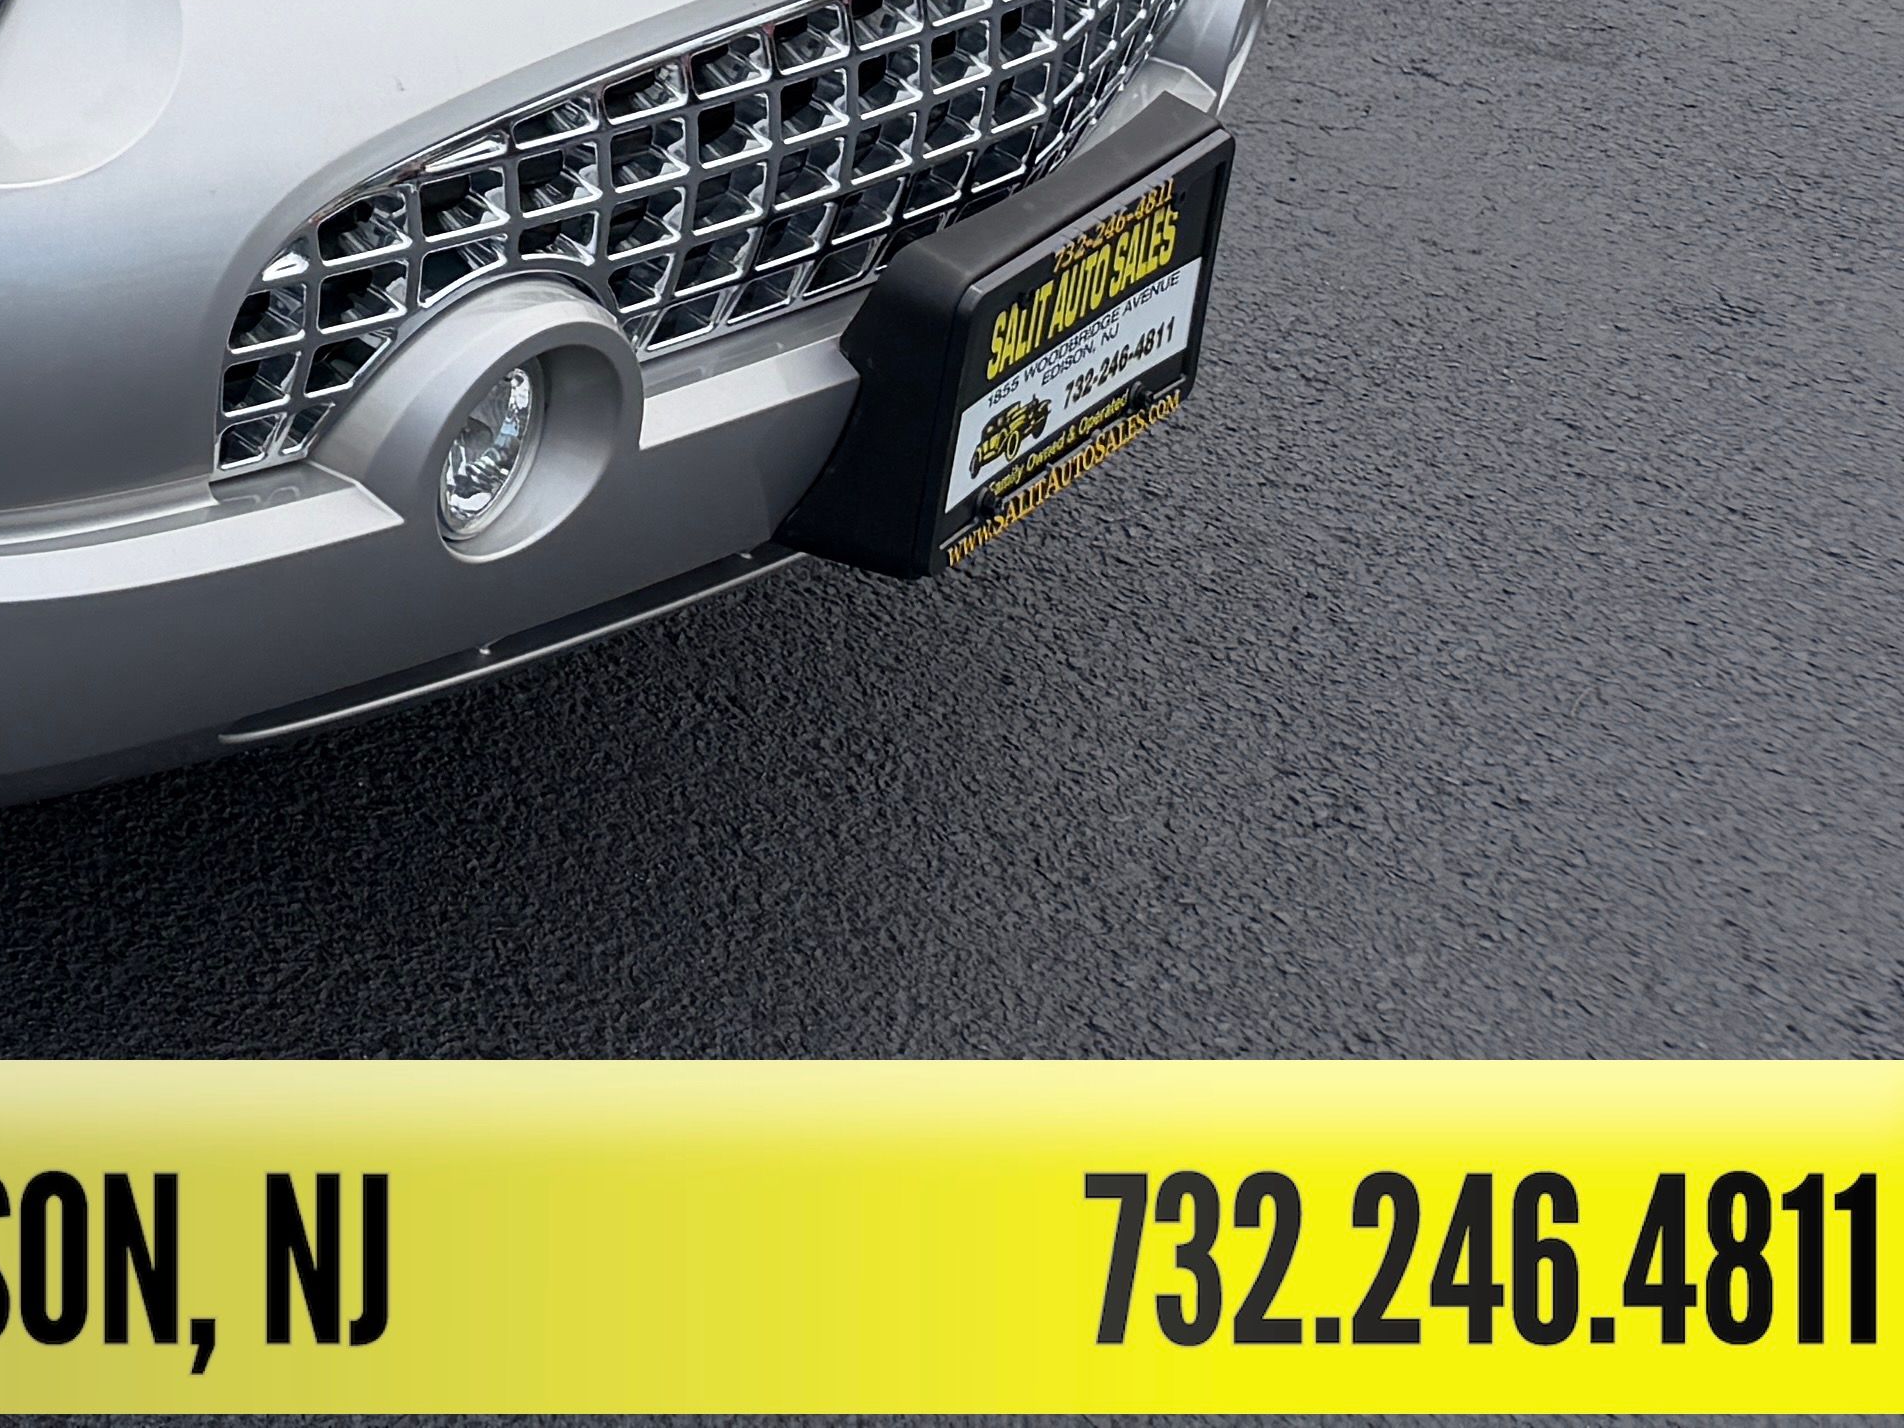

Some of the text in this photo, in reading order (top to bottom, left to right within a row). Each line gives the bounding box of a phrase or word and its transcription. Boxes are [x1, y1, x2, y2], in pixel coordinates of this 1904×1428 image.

[1053, 177, 1175, 273] 732-246-4811
[986, 205, 1179, 380] SALIT AUTO SALES
[988, 270, 1181, 408] 1855 WOODBRIDGE AVENUE
[1101, 323, 1120, 346] NJ
[1063, 315, 1176, 410] 732-246-4811
[1026, 440, 1067, 472] Owned
[1078, 388, 1129, 436] Operated
